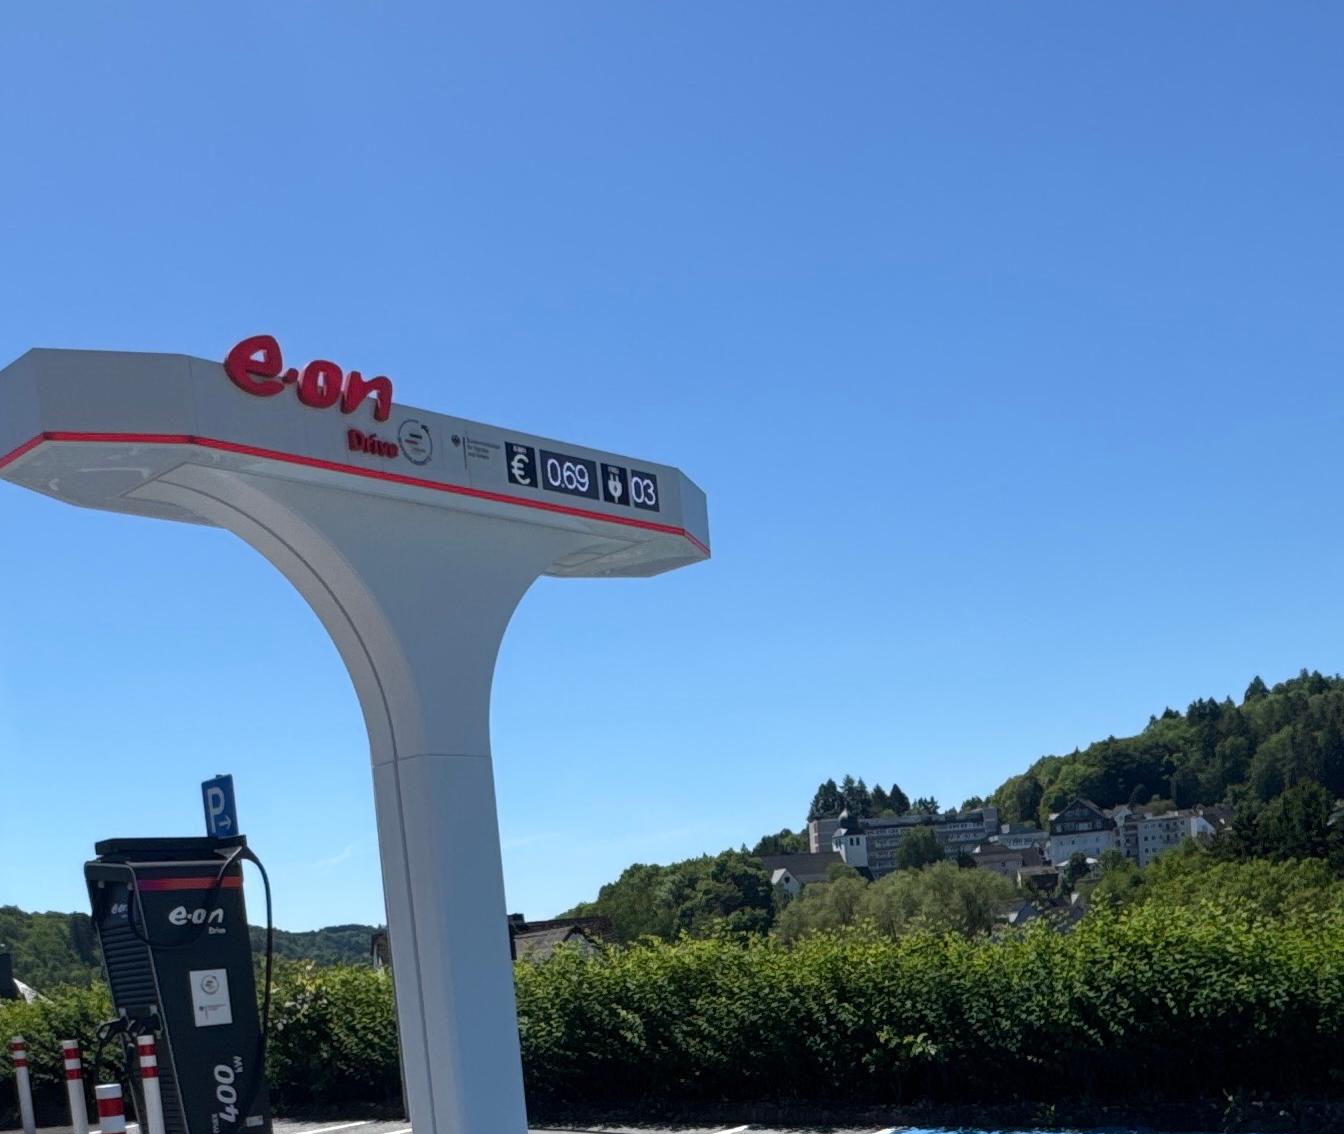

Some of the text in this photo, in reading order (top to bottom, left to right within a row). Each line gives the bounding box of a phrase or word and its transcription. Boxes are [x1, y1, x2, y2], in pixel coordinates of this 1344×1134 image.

[346, 428, 399, 459] Drive
[546, 458, 589, 492] 0.69
[630, 476, 656, 505] 03
[207, 786, 225, 834] P
[213, 1063, 240, 1123] 400
